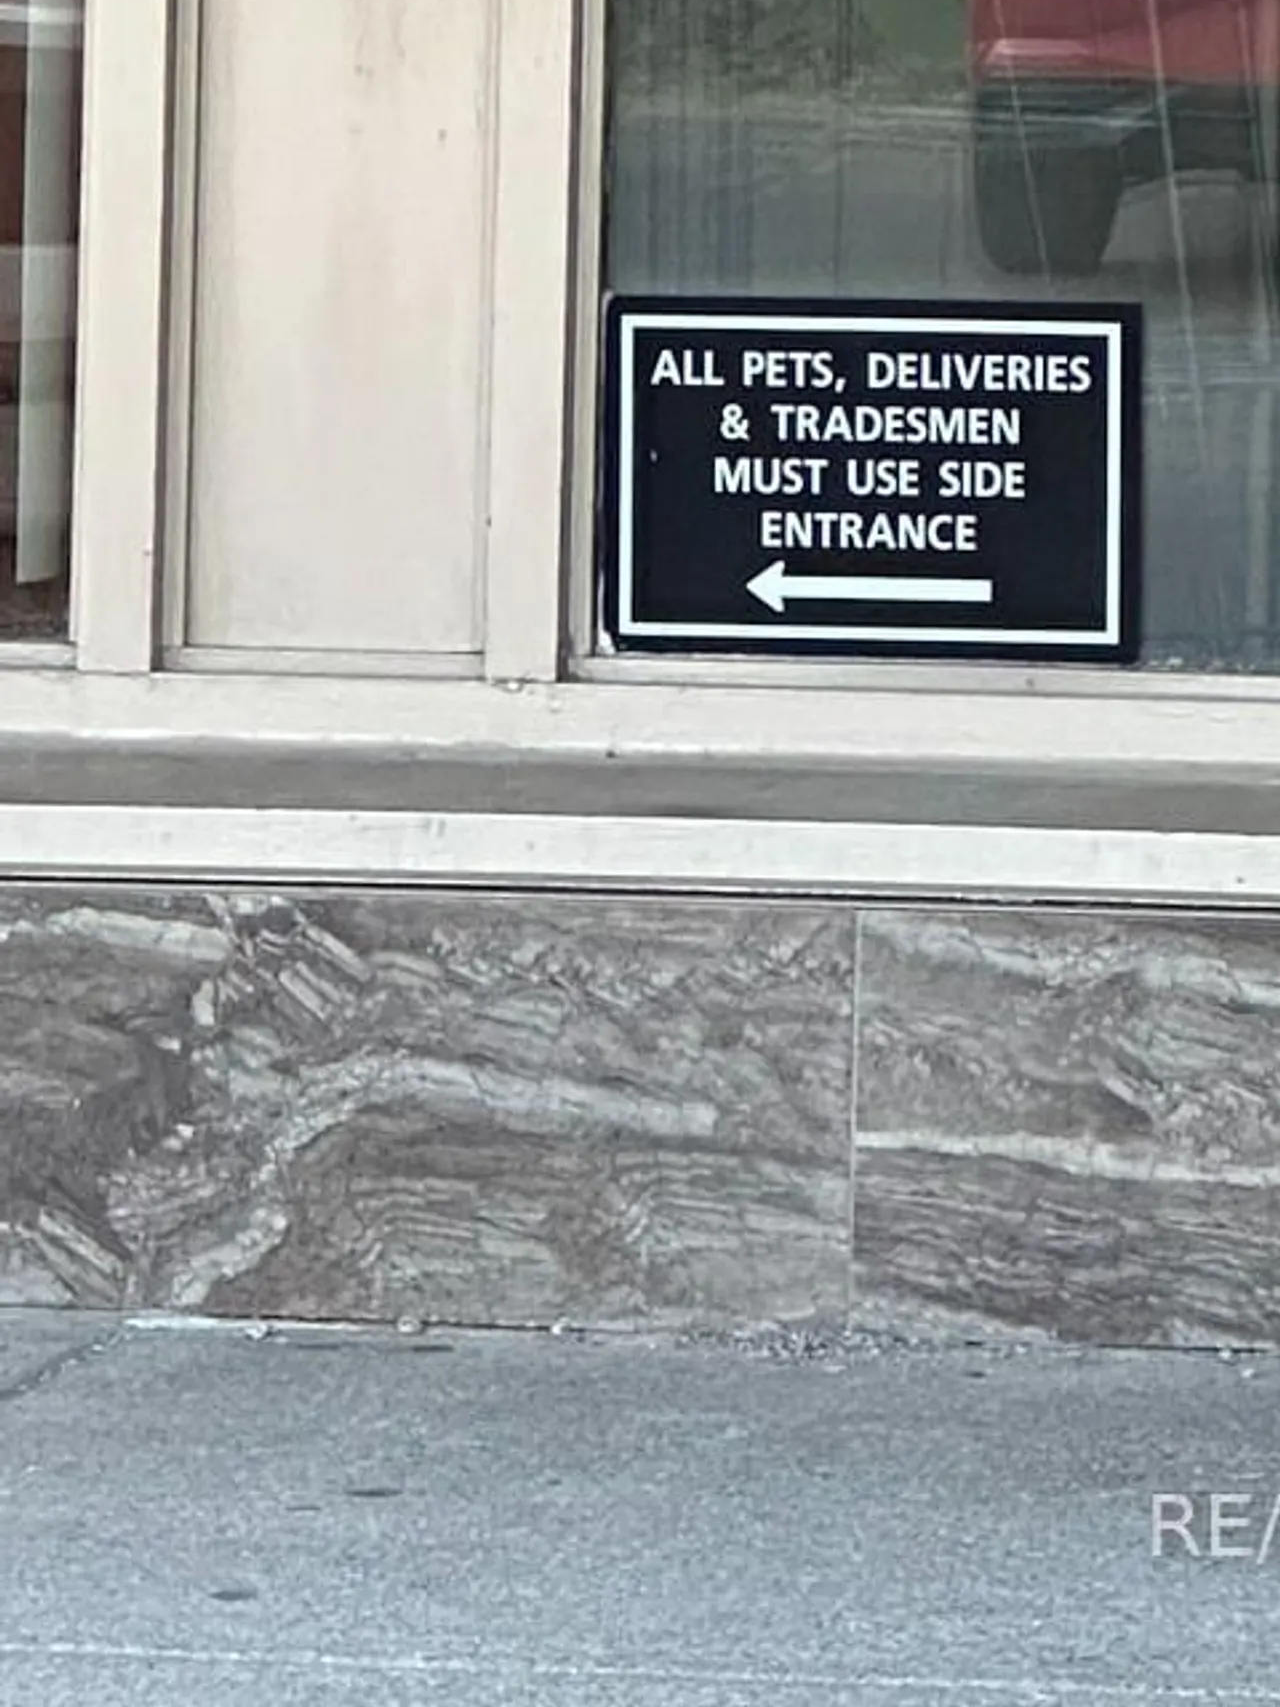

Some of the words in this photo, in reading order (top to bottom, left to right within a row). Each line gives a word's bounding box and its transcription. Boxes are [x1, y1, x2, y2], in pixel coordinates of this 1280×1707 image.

[649, 348, 725, 387] ALL
[742, 350, 847, 393] PETS,
[867, 352, 1092, 393] DELIVERIES
[719, 403, 750, 441] &
[771, 404, 1022, 445] TRADESMEN
[713, 456, 829, 495] MUST
[846, 459, 920, 496] USE
[938, 461, 1026, 499] SIDE
[760, 511, 979, 551] ENTRANCE
